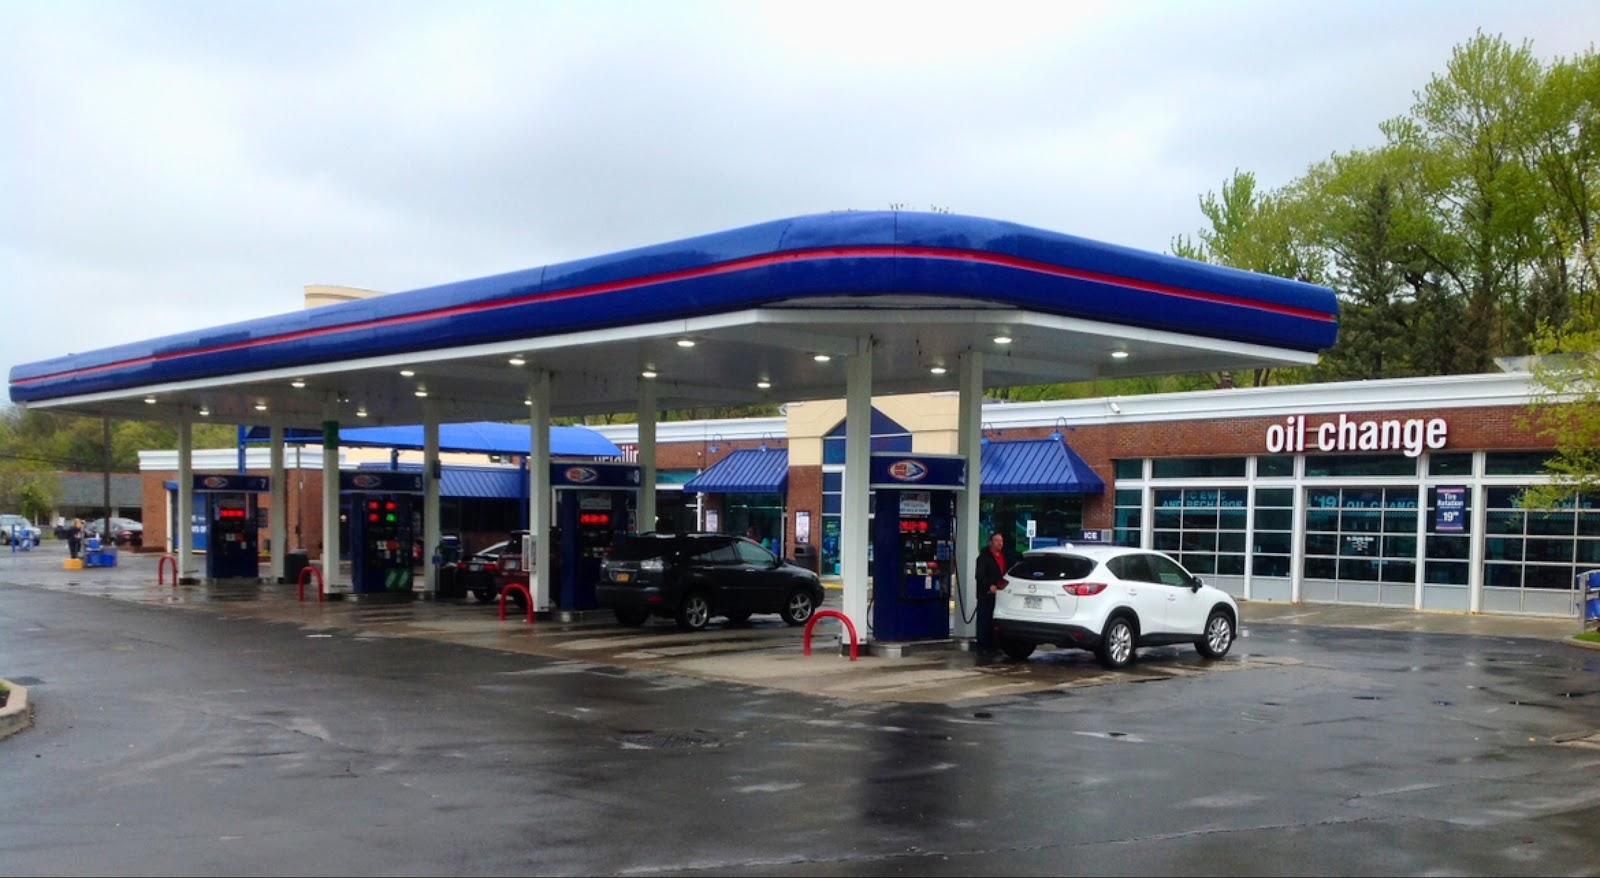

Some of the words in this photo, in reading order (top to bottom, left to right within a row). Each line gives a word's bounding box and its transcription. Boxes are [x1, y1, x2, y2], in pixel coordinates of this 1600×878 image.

[1265, 415, 1305, 453] oil
[1317, 413, 1448, 458] change
[1083, 531, 1098, 540] ICE
